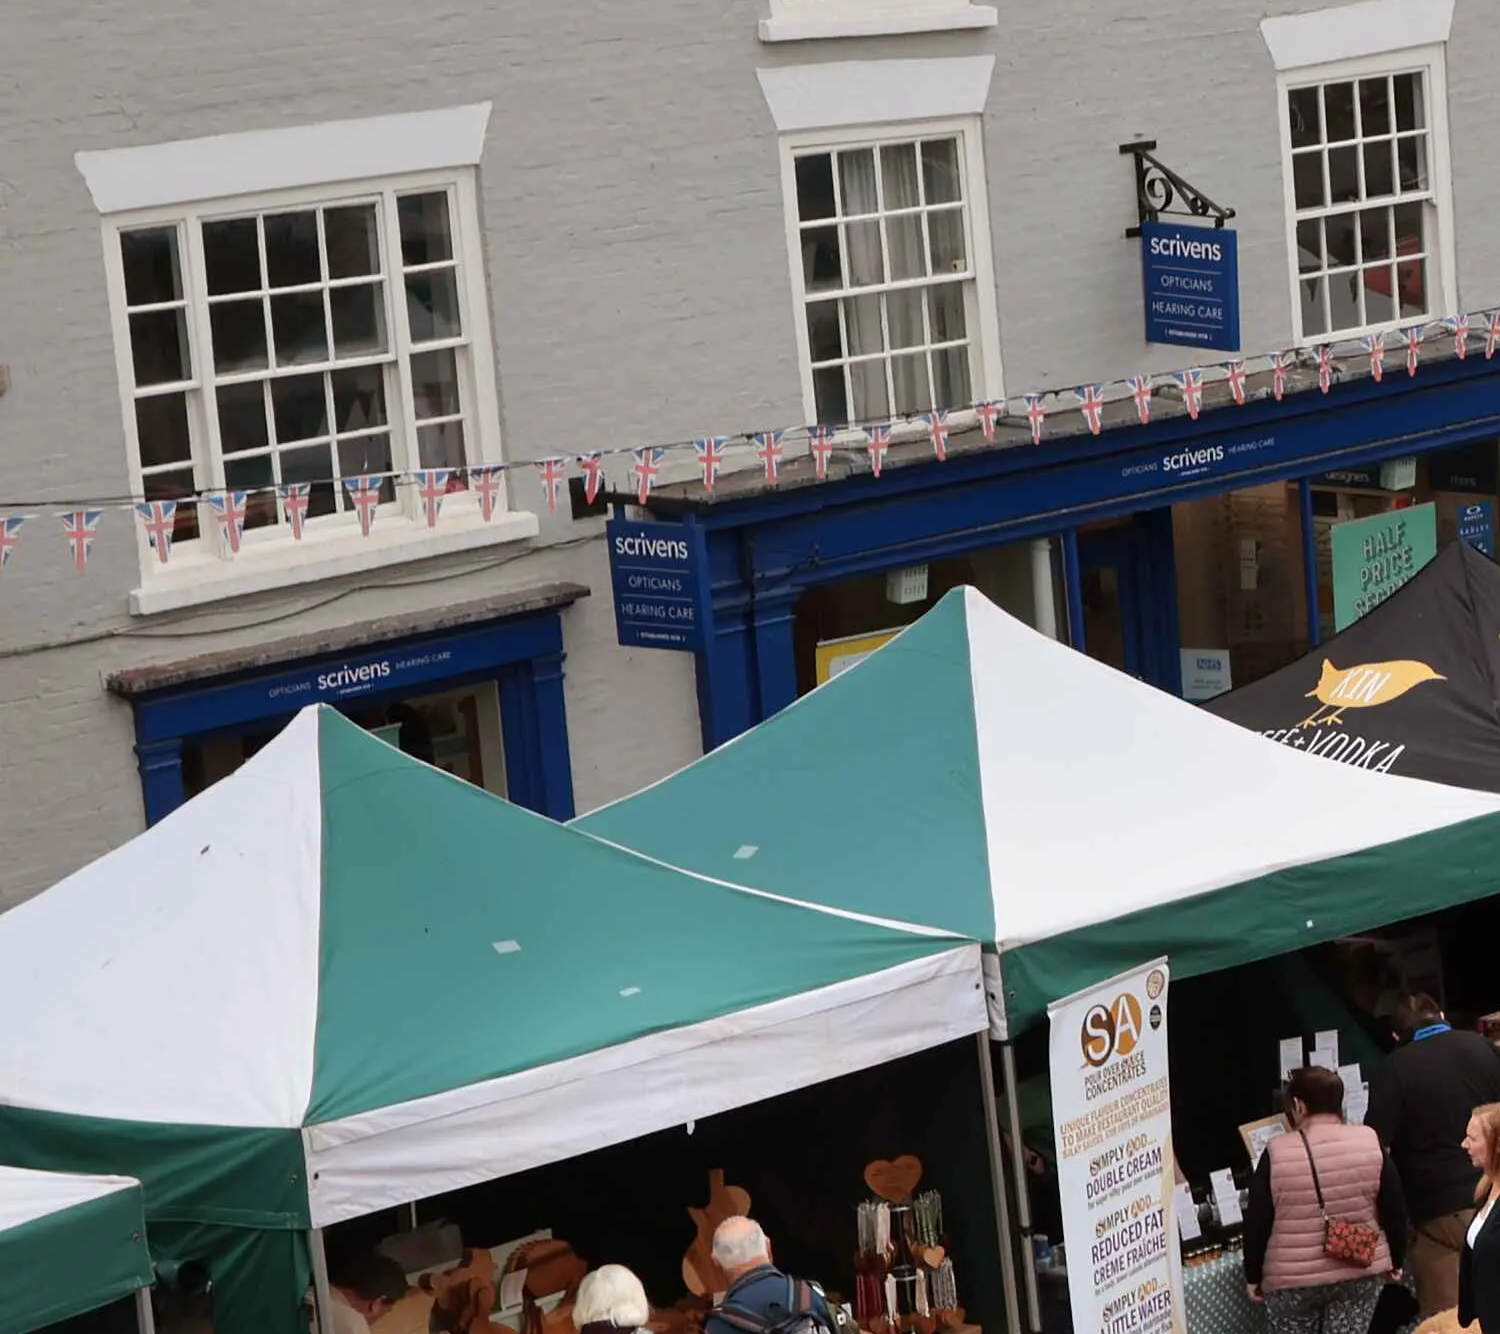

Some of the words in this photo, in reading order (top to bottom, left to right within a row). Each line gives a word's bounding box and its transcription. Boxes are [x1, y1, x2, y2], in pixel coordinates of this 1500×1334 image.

[1150, 233, 1222, 261] scrivens
[1161, 275, 1213, 291] OPTICIANS
[1152, 300, 1195, 317] HEARING
[1197, 306, 1223, 320] CARE
[1121, 462, 1158, 477] OPTICIANS
[1163, 445, 1224, 471] scrivens
[1228, 442, 1257, 454] HEARING
[1258, 437, 1275, 448] CARE
[615, 532, 688, 559] scrivens
[1363, 520, 1406, 561] HALF
[628, 575, 682, 591] OPTICIANS
[1360, 547, 1414, 591] PRICE
[621, 603, 665, 619] HEARING
[668, 607, 694, 620] CARE
[269, 681, 312, 698] OPTICIANS
[318, 660, 390, 690] scrivens
[396, 656, 430, 670] HEARING
[432, 651, 452, 662] CARE
[1331, 668, 1391, 703] KIN
[1086, 995, 1138, 1061] SA
[1086, 1063, 1145, 1101] CONCENTRATES
[1103, 1061, 1120, 1079] OVER
[1062, 1134, 1075, 1148] TO
[1086, 1167, 1125, 1199] DOUBLE
[1126, 1146, 1162, 1178] CREAM
[1091, 1220, 1142, 1265] REDUCED
[1145, 1208, 1164, 1234] FAT
[1138, 1290, 1171, 1322] WATER
